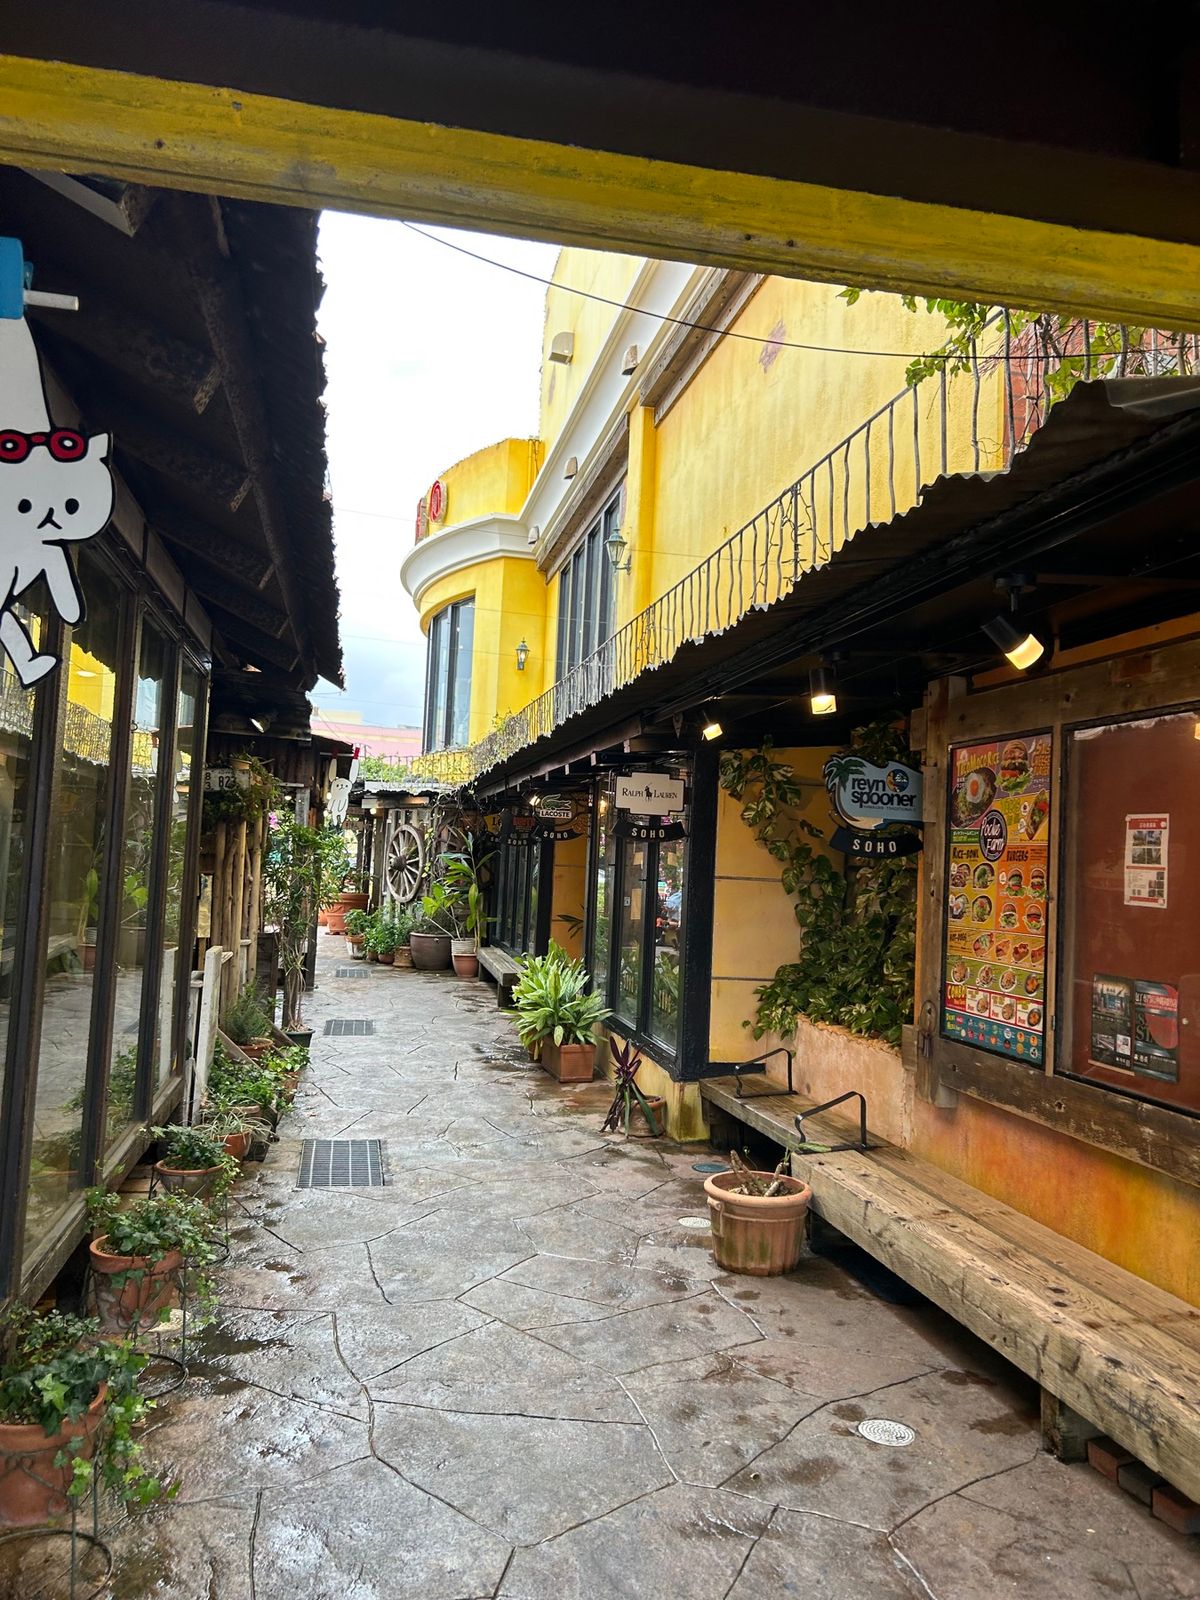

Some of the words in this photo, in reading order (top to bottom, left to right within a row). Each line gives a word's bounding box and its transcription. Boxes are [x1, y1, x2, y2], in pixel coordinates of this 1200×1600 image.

[851, 777, 886, 793] reyn
[622, 787, 644, 797] RALPH
[653, 789, 678, 799] LAUREN
[851, 791, 917, 808] spooner
[543, 831, 568, 839] SOHO
[631, 828, 665, 838] SOHO
[852, 839, 897, 853] SOHO
